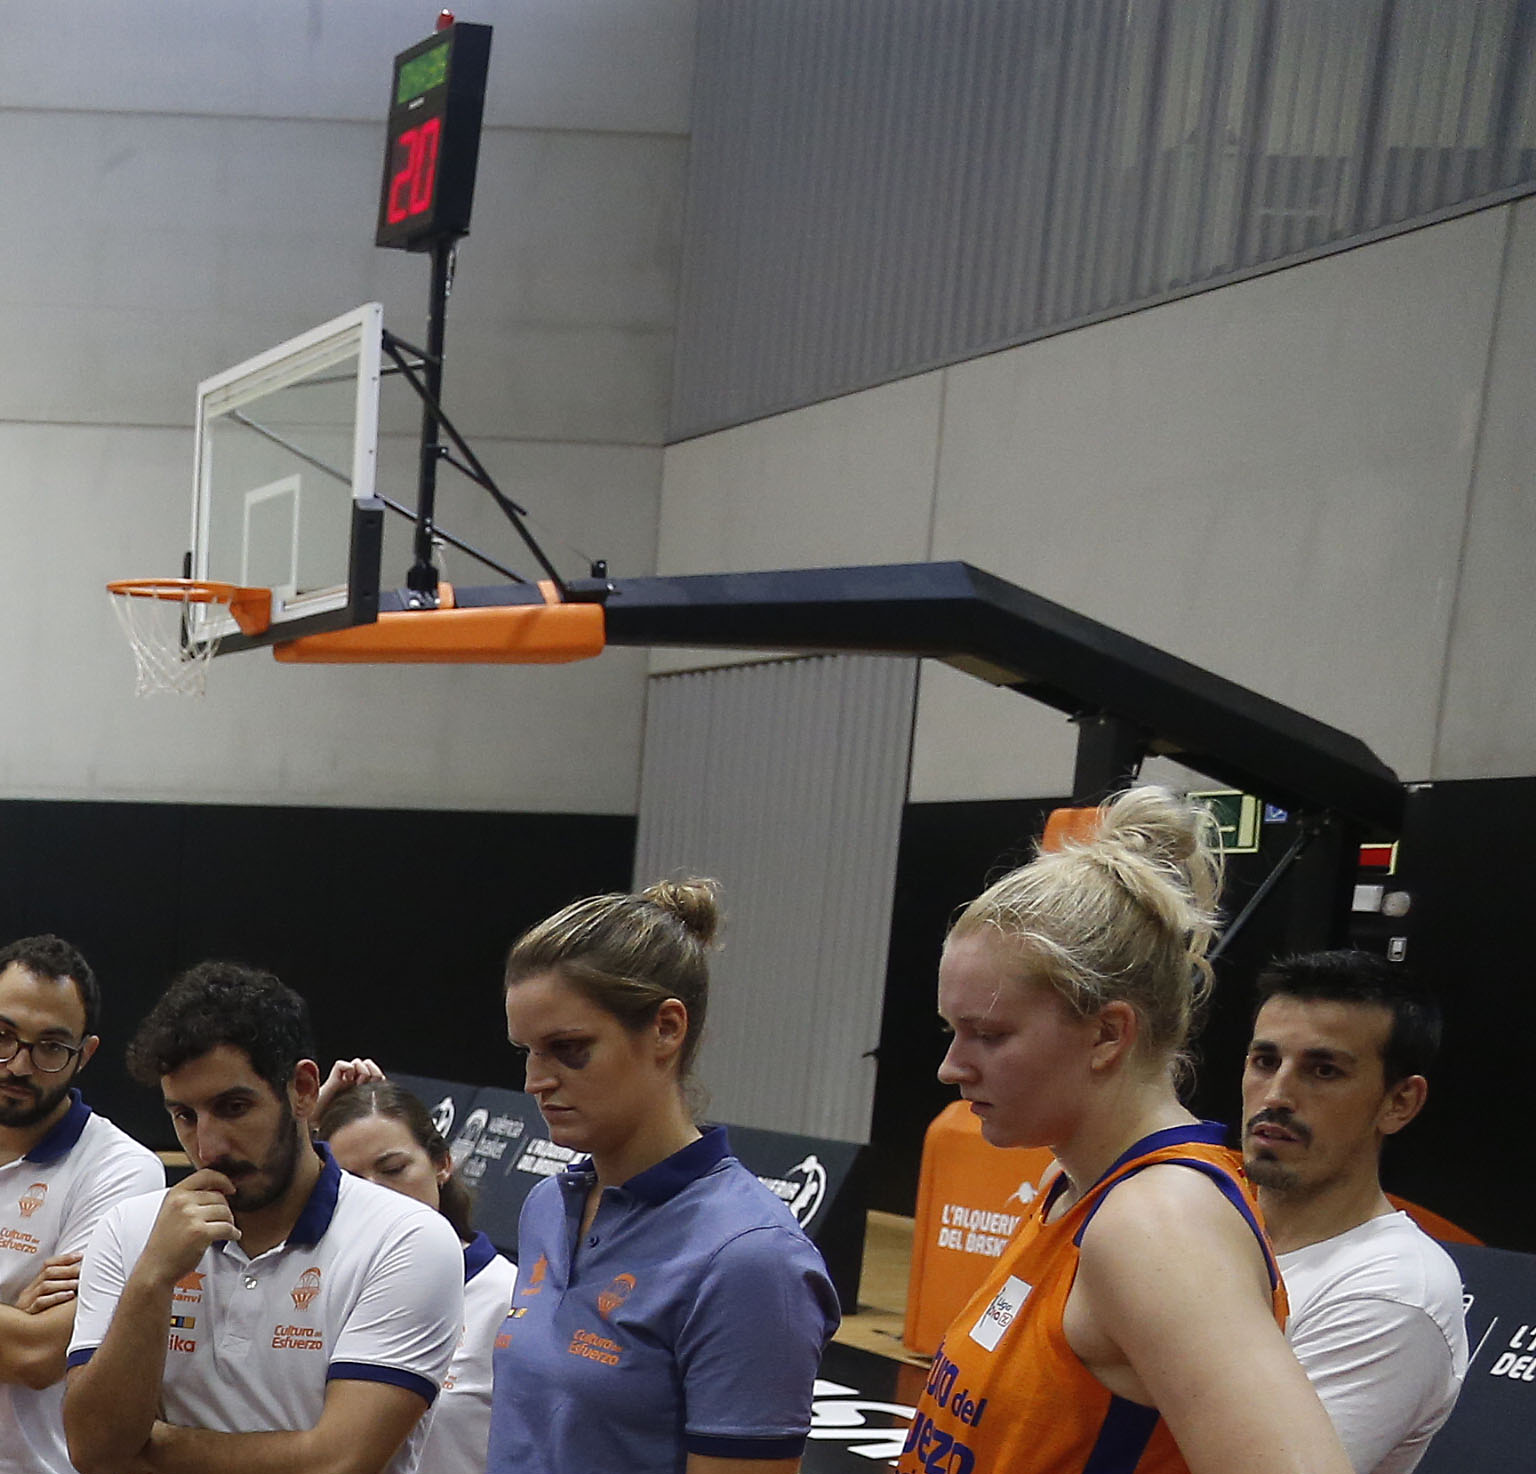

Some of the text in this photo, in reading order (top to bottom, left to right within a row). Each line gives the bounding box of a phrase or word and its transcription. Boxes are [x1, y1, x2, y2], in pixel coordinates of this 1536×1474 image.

[387, 116, 442, 225] 20
[938, 1226, 964, 1251] DEL
[169, 1335, 197, 1354] ika
[271, 1335, 324, 1352] Esfuerzo
